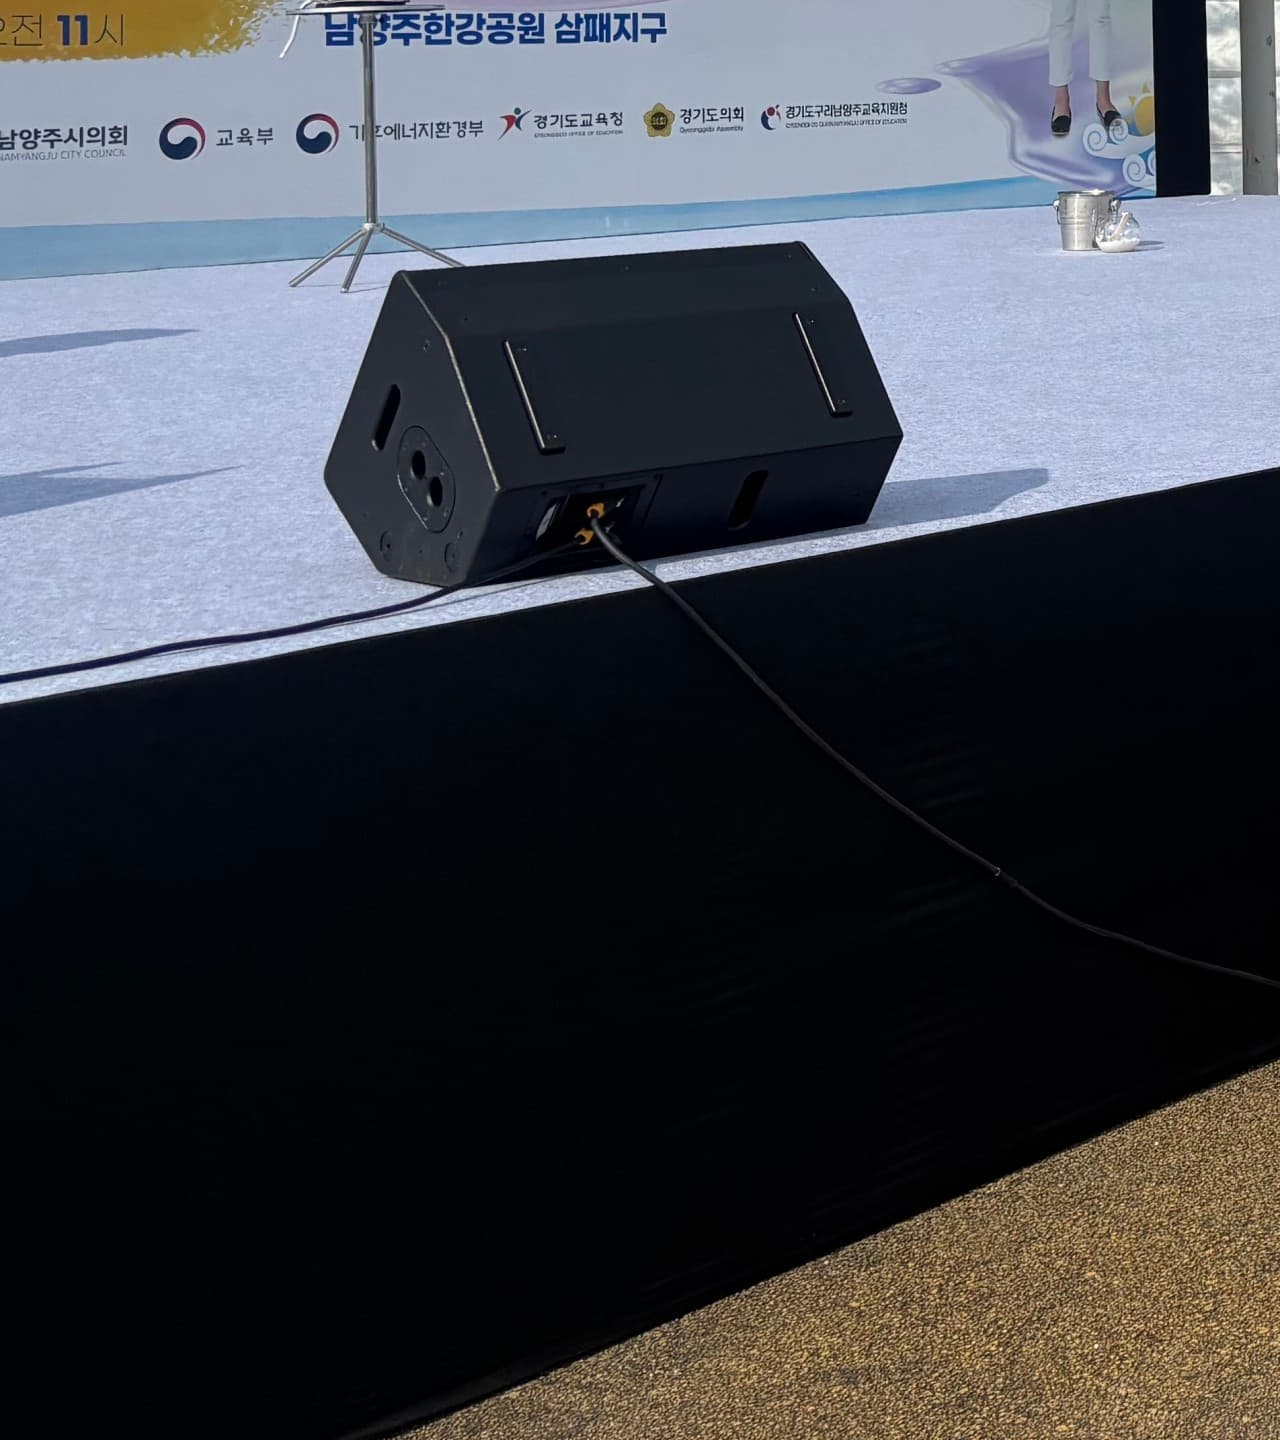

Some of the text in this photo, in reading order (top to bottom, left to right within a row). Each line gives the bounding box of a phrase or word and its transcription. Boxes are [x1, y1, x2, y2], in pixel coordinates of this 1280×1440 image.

[554, 12, 667, 44] 삼패지구
[680, 107, 744, 124] 경기도의회
[785, 102, 908, 119] 경기도구리남양주교육지원청
[533, 112, 623, 130] 경기도교육청
[0, 125, 128, 151] 남양주시의회
[216, 127, 274, 146] 교육부
